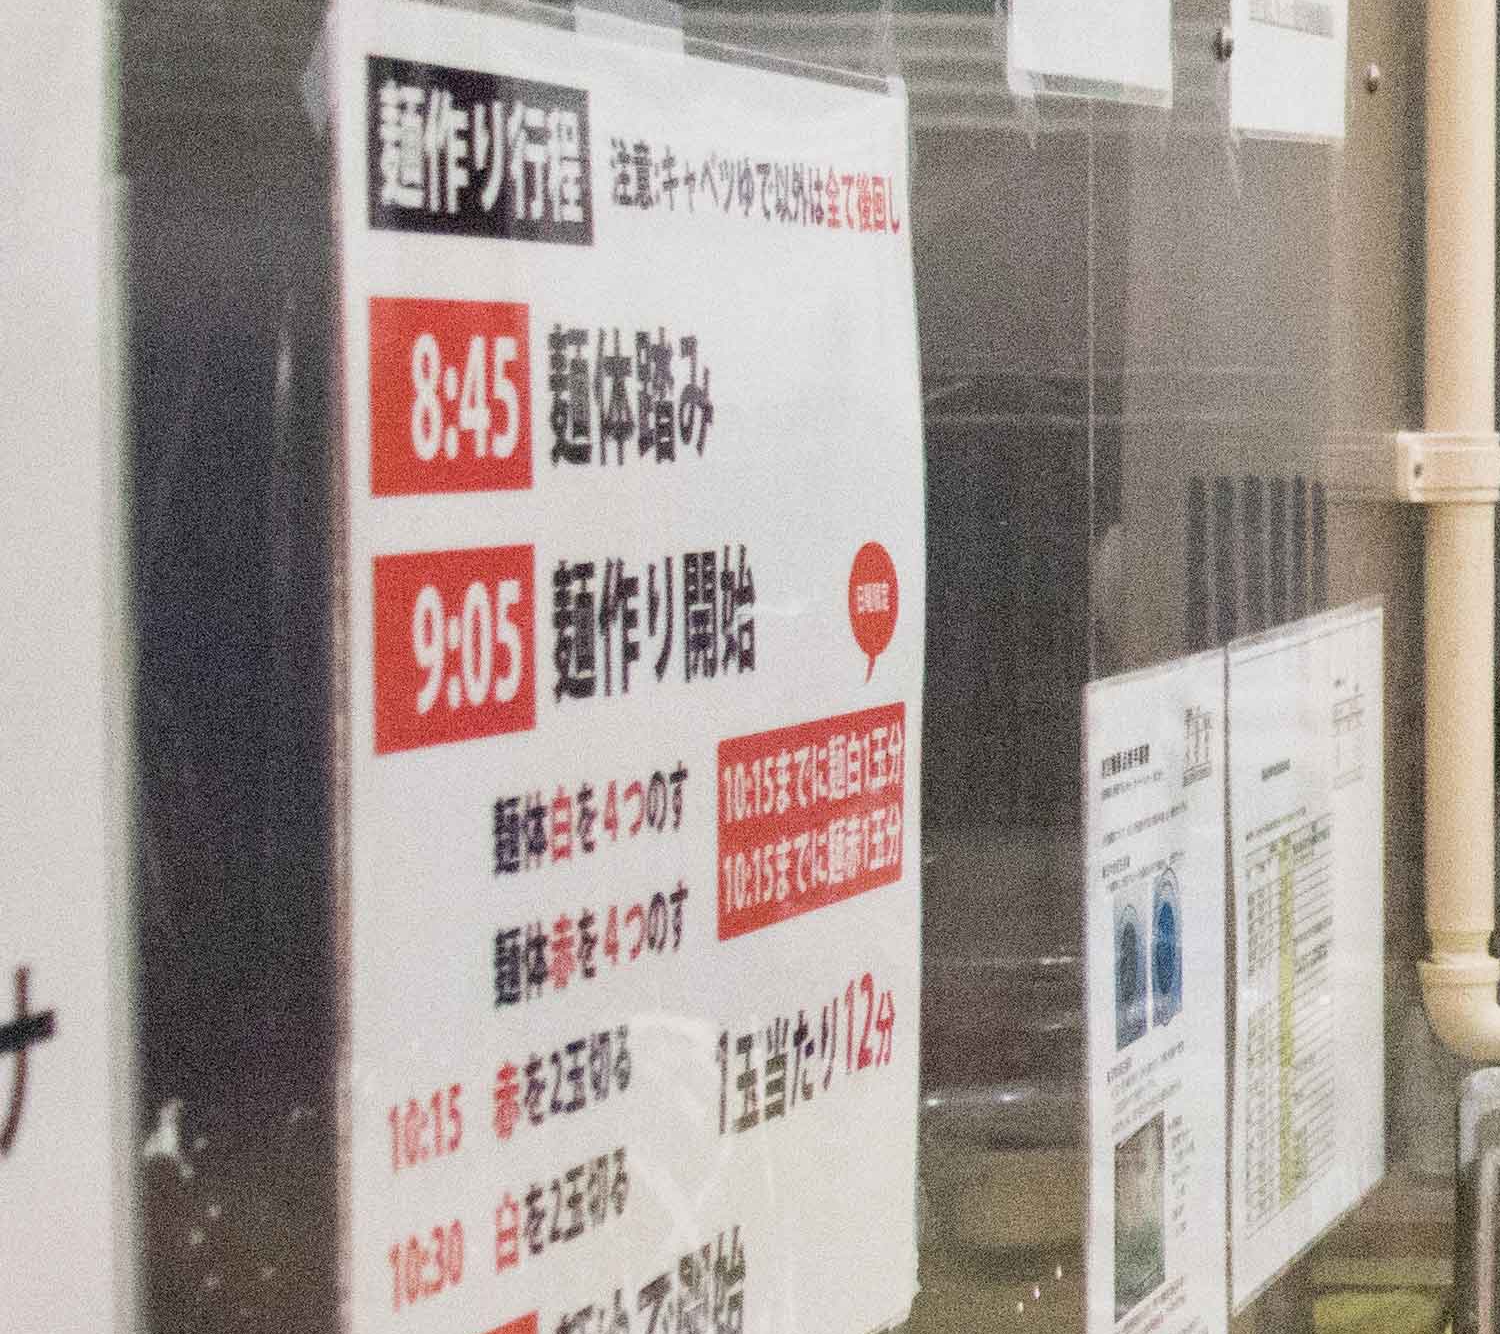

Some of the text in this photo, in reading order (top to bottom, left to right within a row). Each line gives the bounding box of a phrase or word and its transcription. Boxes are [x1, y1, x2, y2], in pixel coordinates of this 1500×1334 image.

[379, 79, 586, 224] 麺作り行程
[410, 332, 522, 462] 8:45
[548, 323, 714, 466] 麺体踏み
[412, 579, 523, 715] 9:05
[552, 543, 756, 703] 麺作り開始
[494, 761, 688, 876] 麺体白を4つのす
[494, 879, 689, 1009] 麺体赤を4つのす
[388, 1023, 633, 1173] 10:15 赤を2玉切る
[715, 972, 897, 1135] 1玉当たり12分
[388, 1147, 628, 1314] 10:30 白を2玉切る
